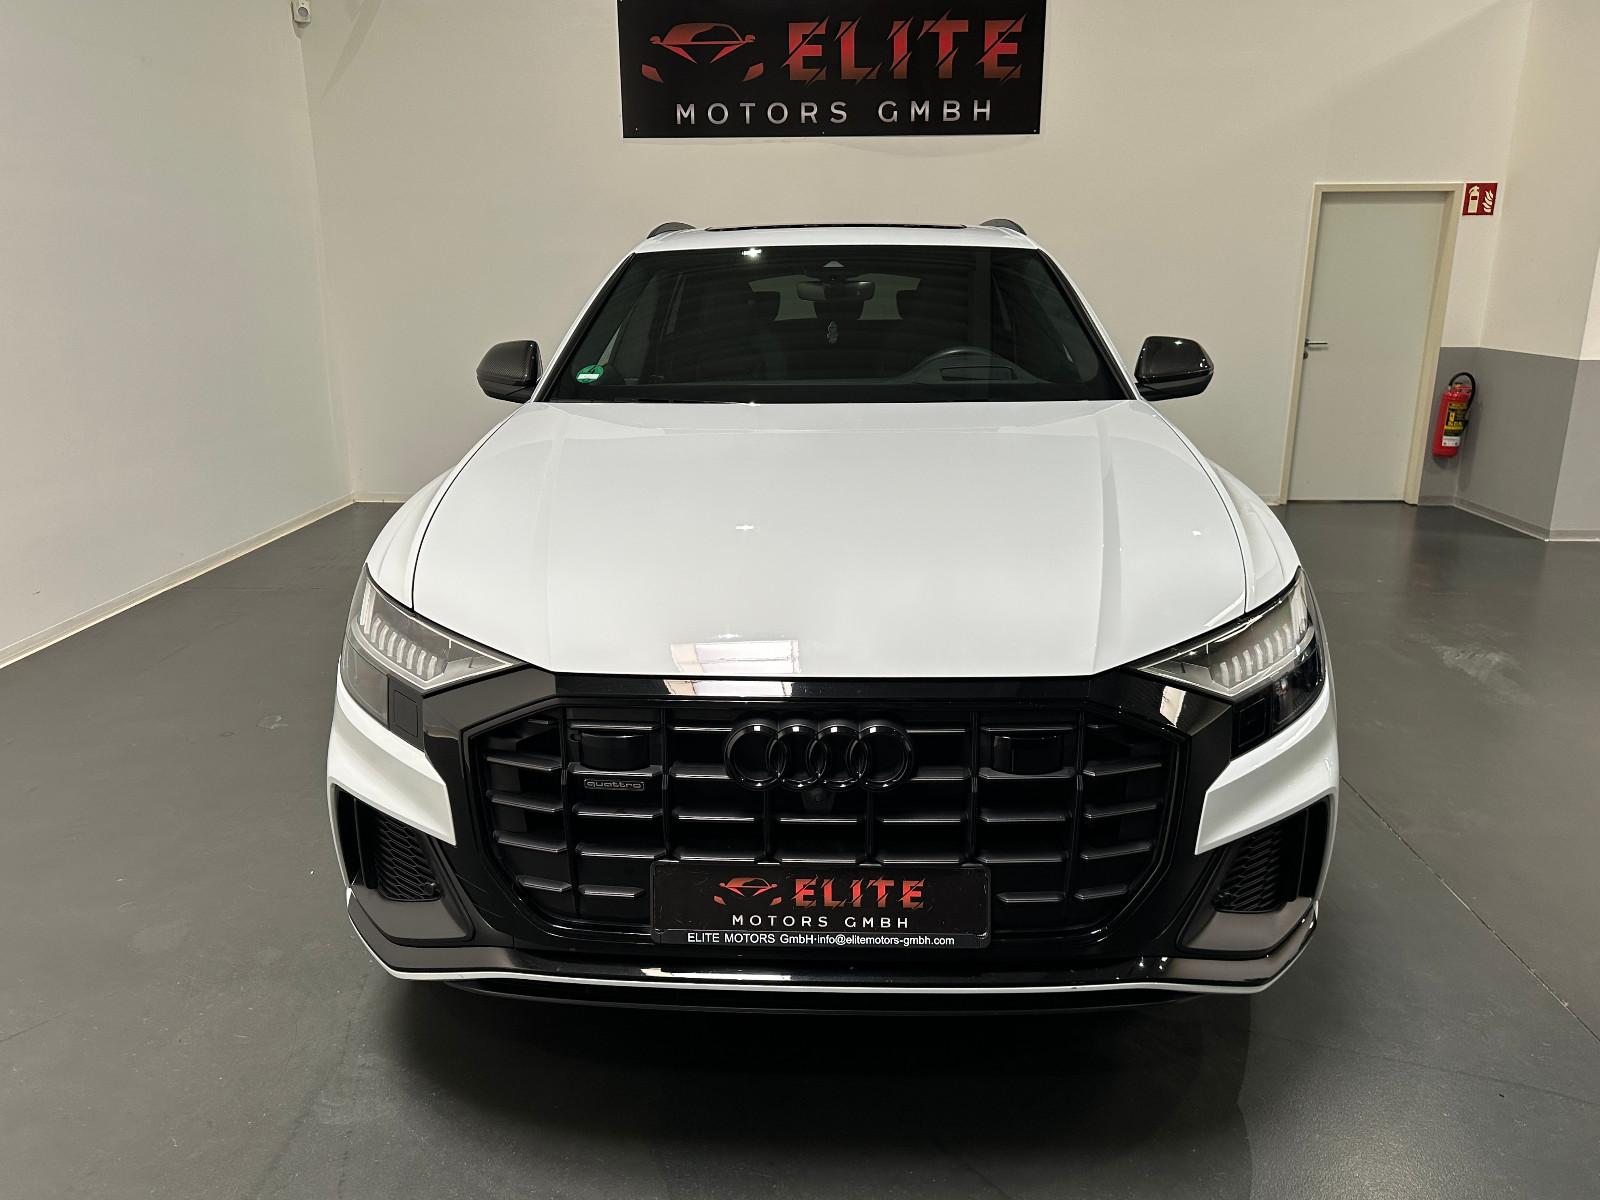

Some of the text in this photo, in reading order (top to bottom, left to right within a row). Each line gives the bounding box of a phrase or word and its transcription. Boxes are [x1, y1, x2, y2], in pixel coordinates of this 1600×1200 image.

[783, 12, 1026, 85] ELITE
[676, 99, 992, 125] MOTORS GMBH
[793, 877, 926, 909] ELITE
[732, 914, 908, 929] MOTORS GMBH
[687, 932, 720, 943] ELITE
[724, 933, 776, 944] MOTORS
